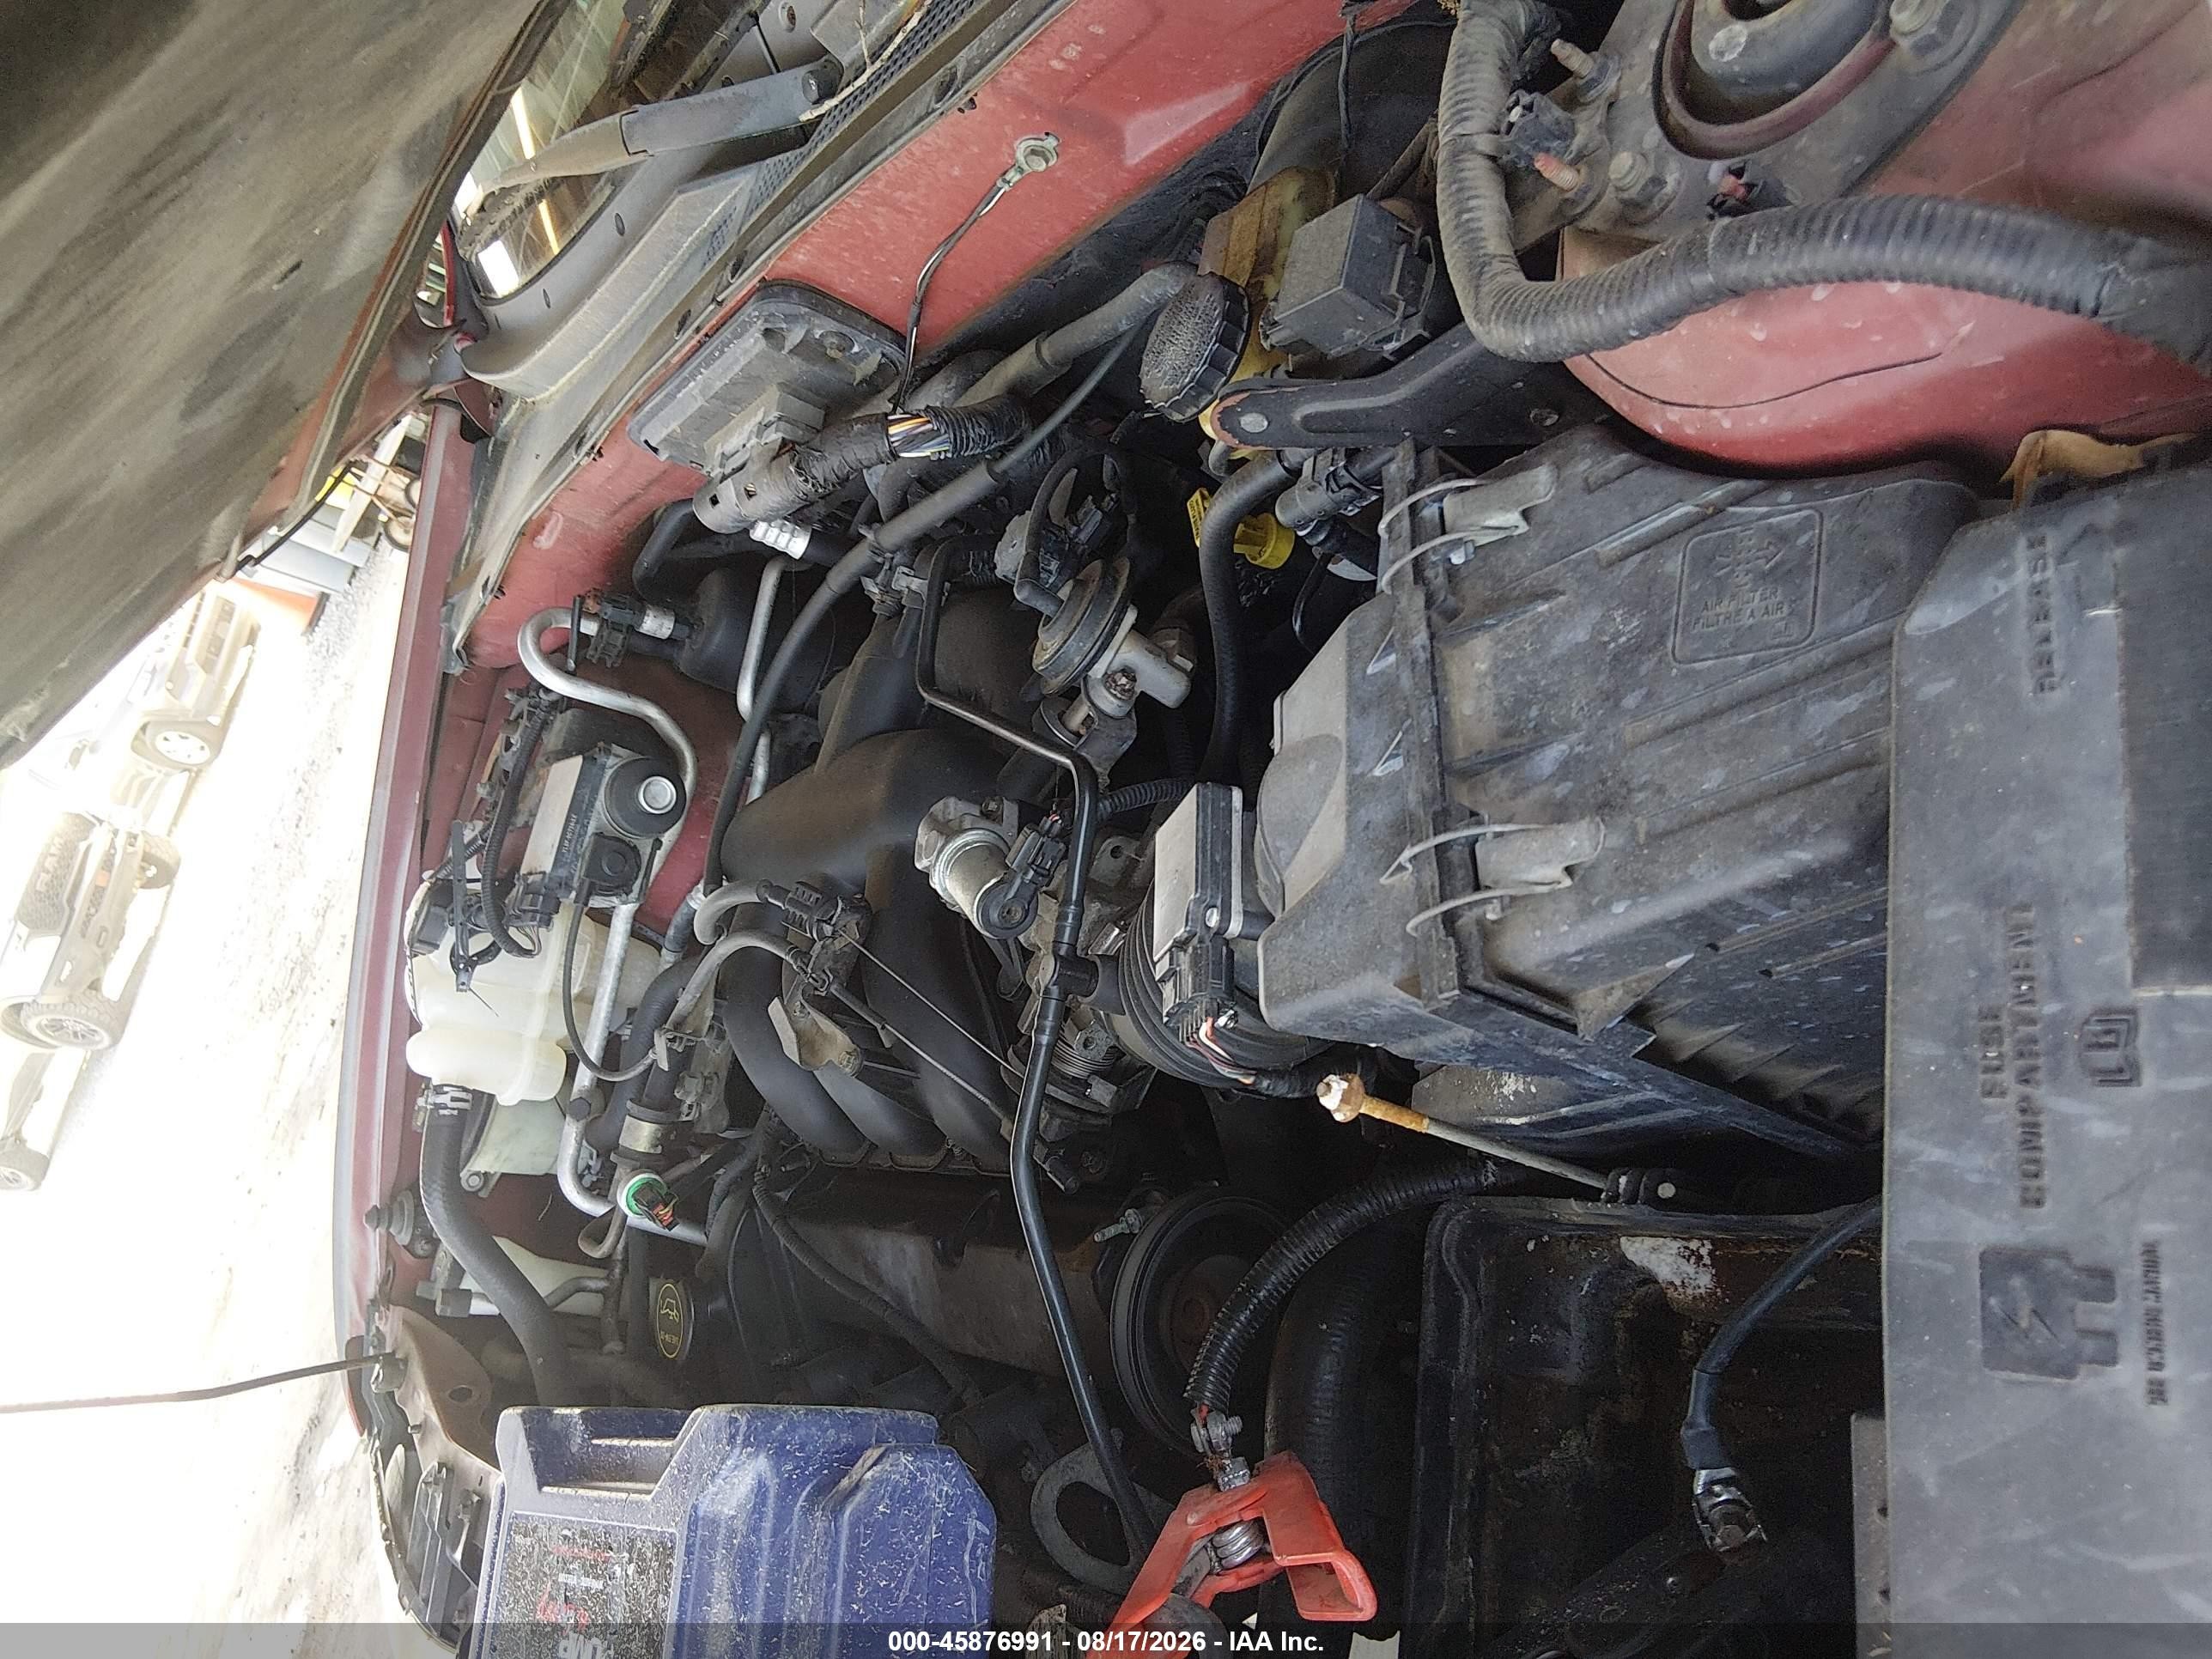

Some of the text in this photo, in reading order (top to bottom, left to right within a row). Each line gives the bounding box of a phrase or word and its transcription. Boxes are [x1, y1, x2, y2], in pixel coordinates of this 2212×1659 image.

[1691, 606, 1746, 631] FILTRE
[1761, 601, 1785, 618] AIR
[1701, 586, 1780, 613] AIR FILTER
[1978, 1005, 2008, 1100] FUSE
[2006, 902, 2045, 1209] COMPARTMENT
